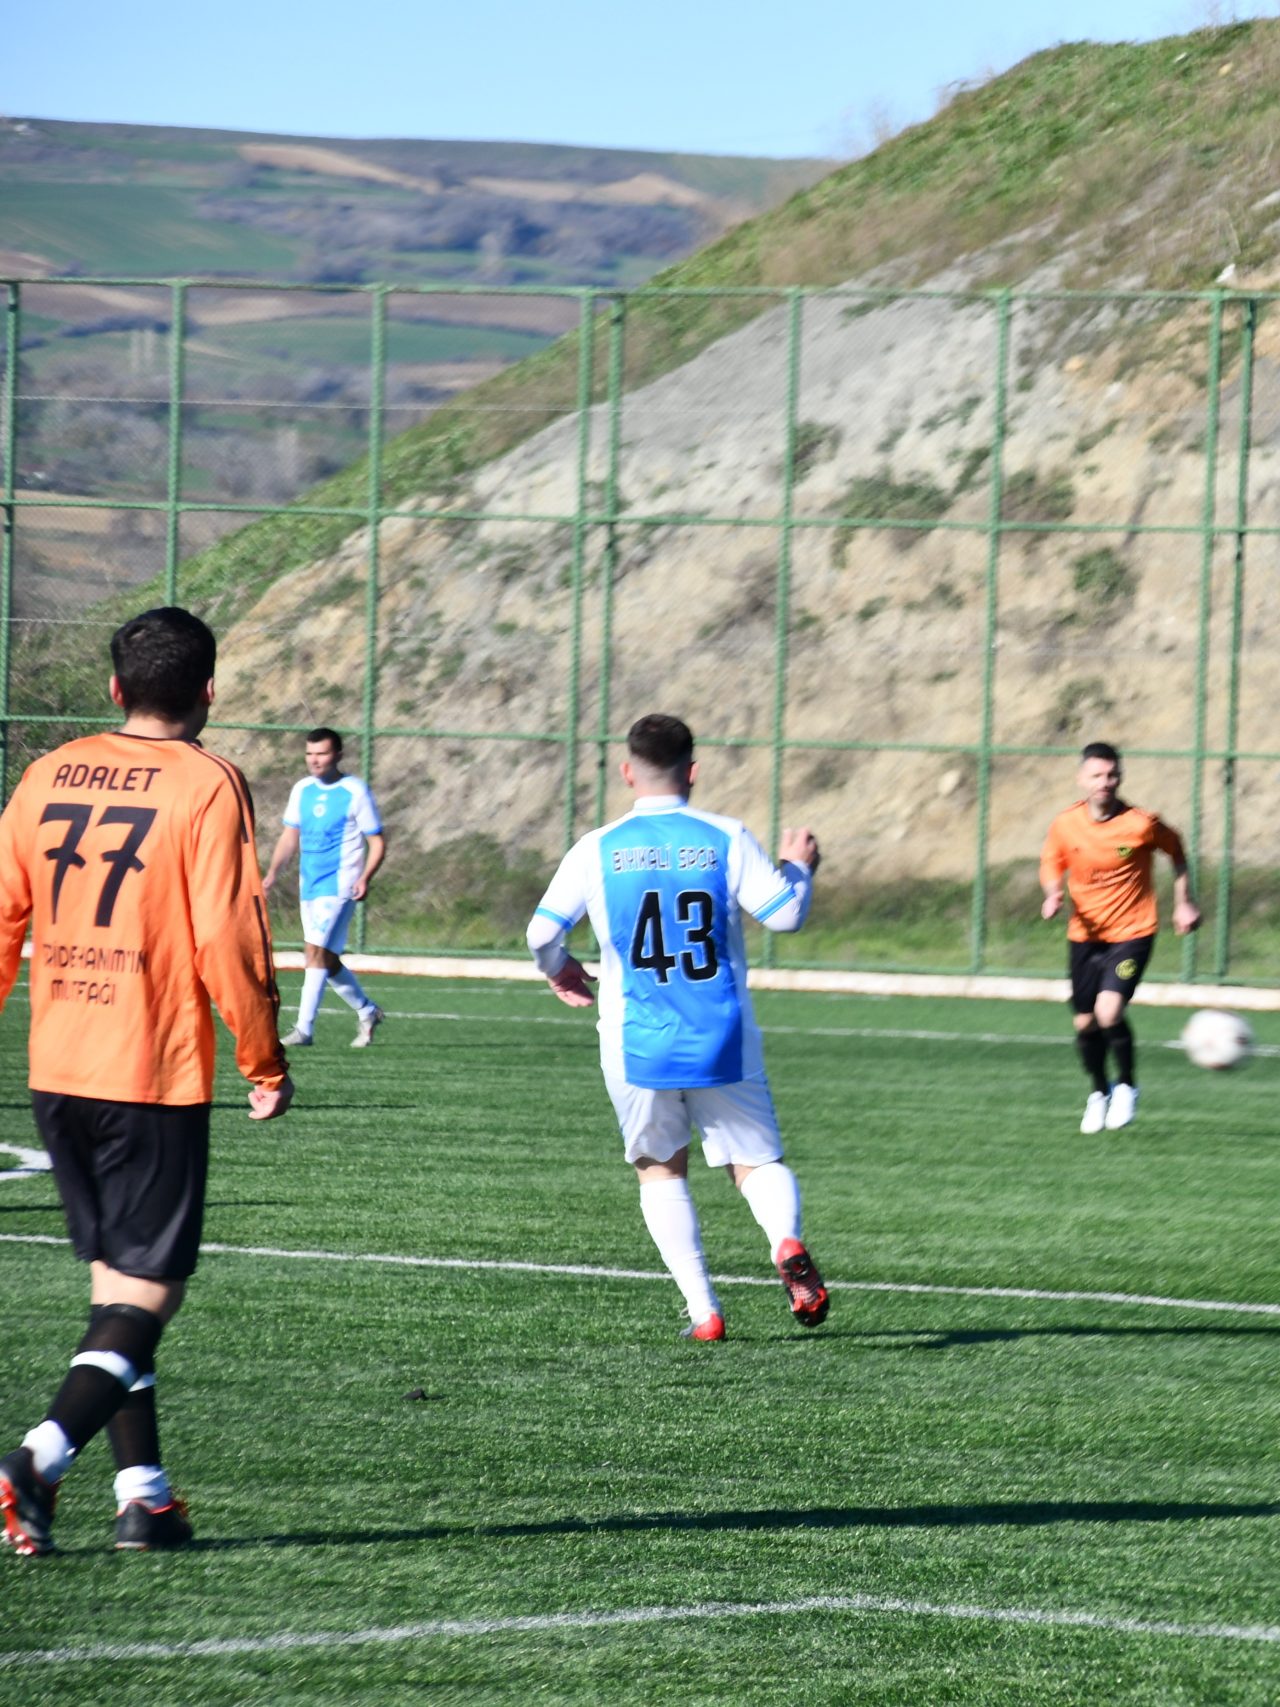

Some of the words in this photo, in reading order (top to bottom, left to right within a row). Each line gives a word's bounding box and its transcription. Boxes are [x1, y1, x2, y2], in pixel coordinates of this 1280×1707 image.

[52, 764, 161, 793] ADALET
[38, 803, 158, 928] 77
[629, 889, 719, 985] 43
